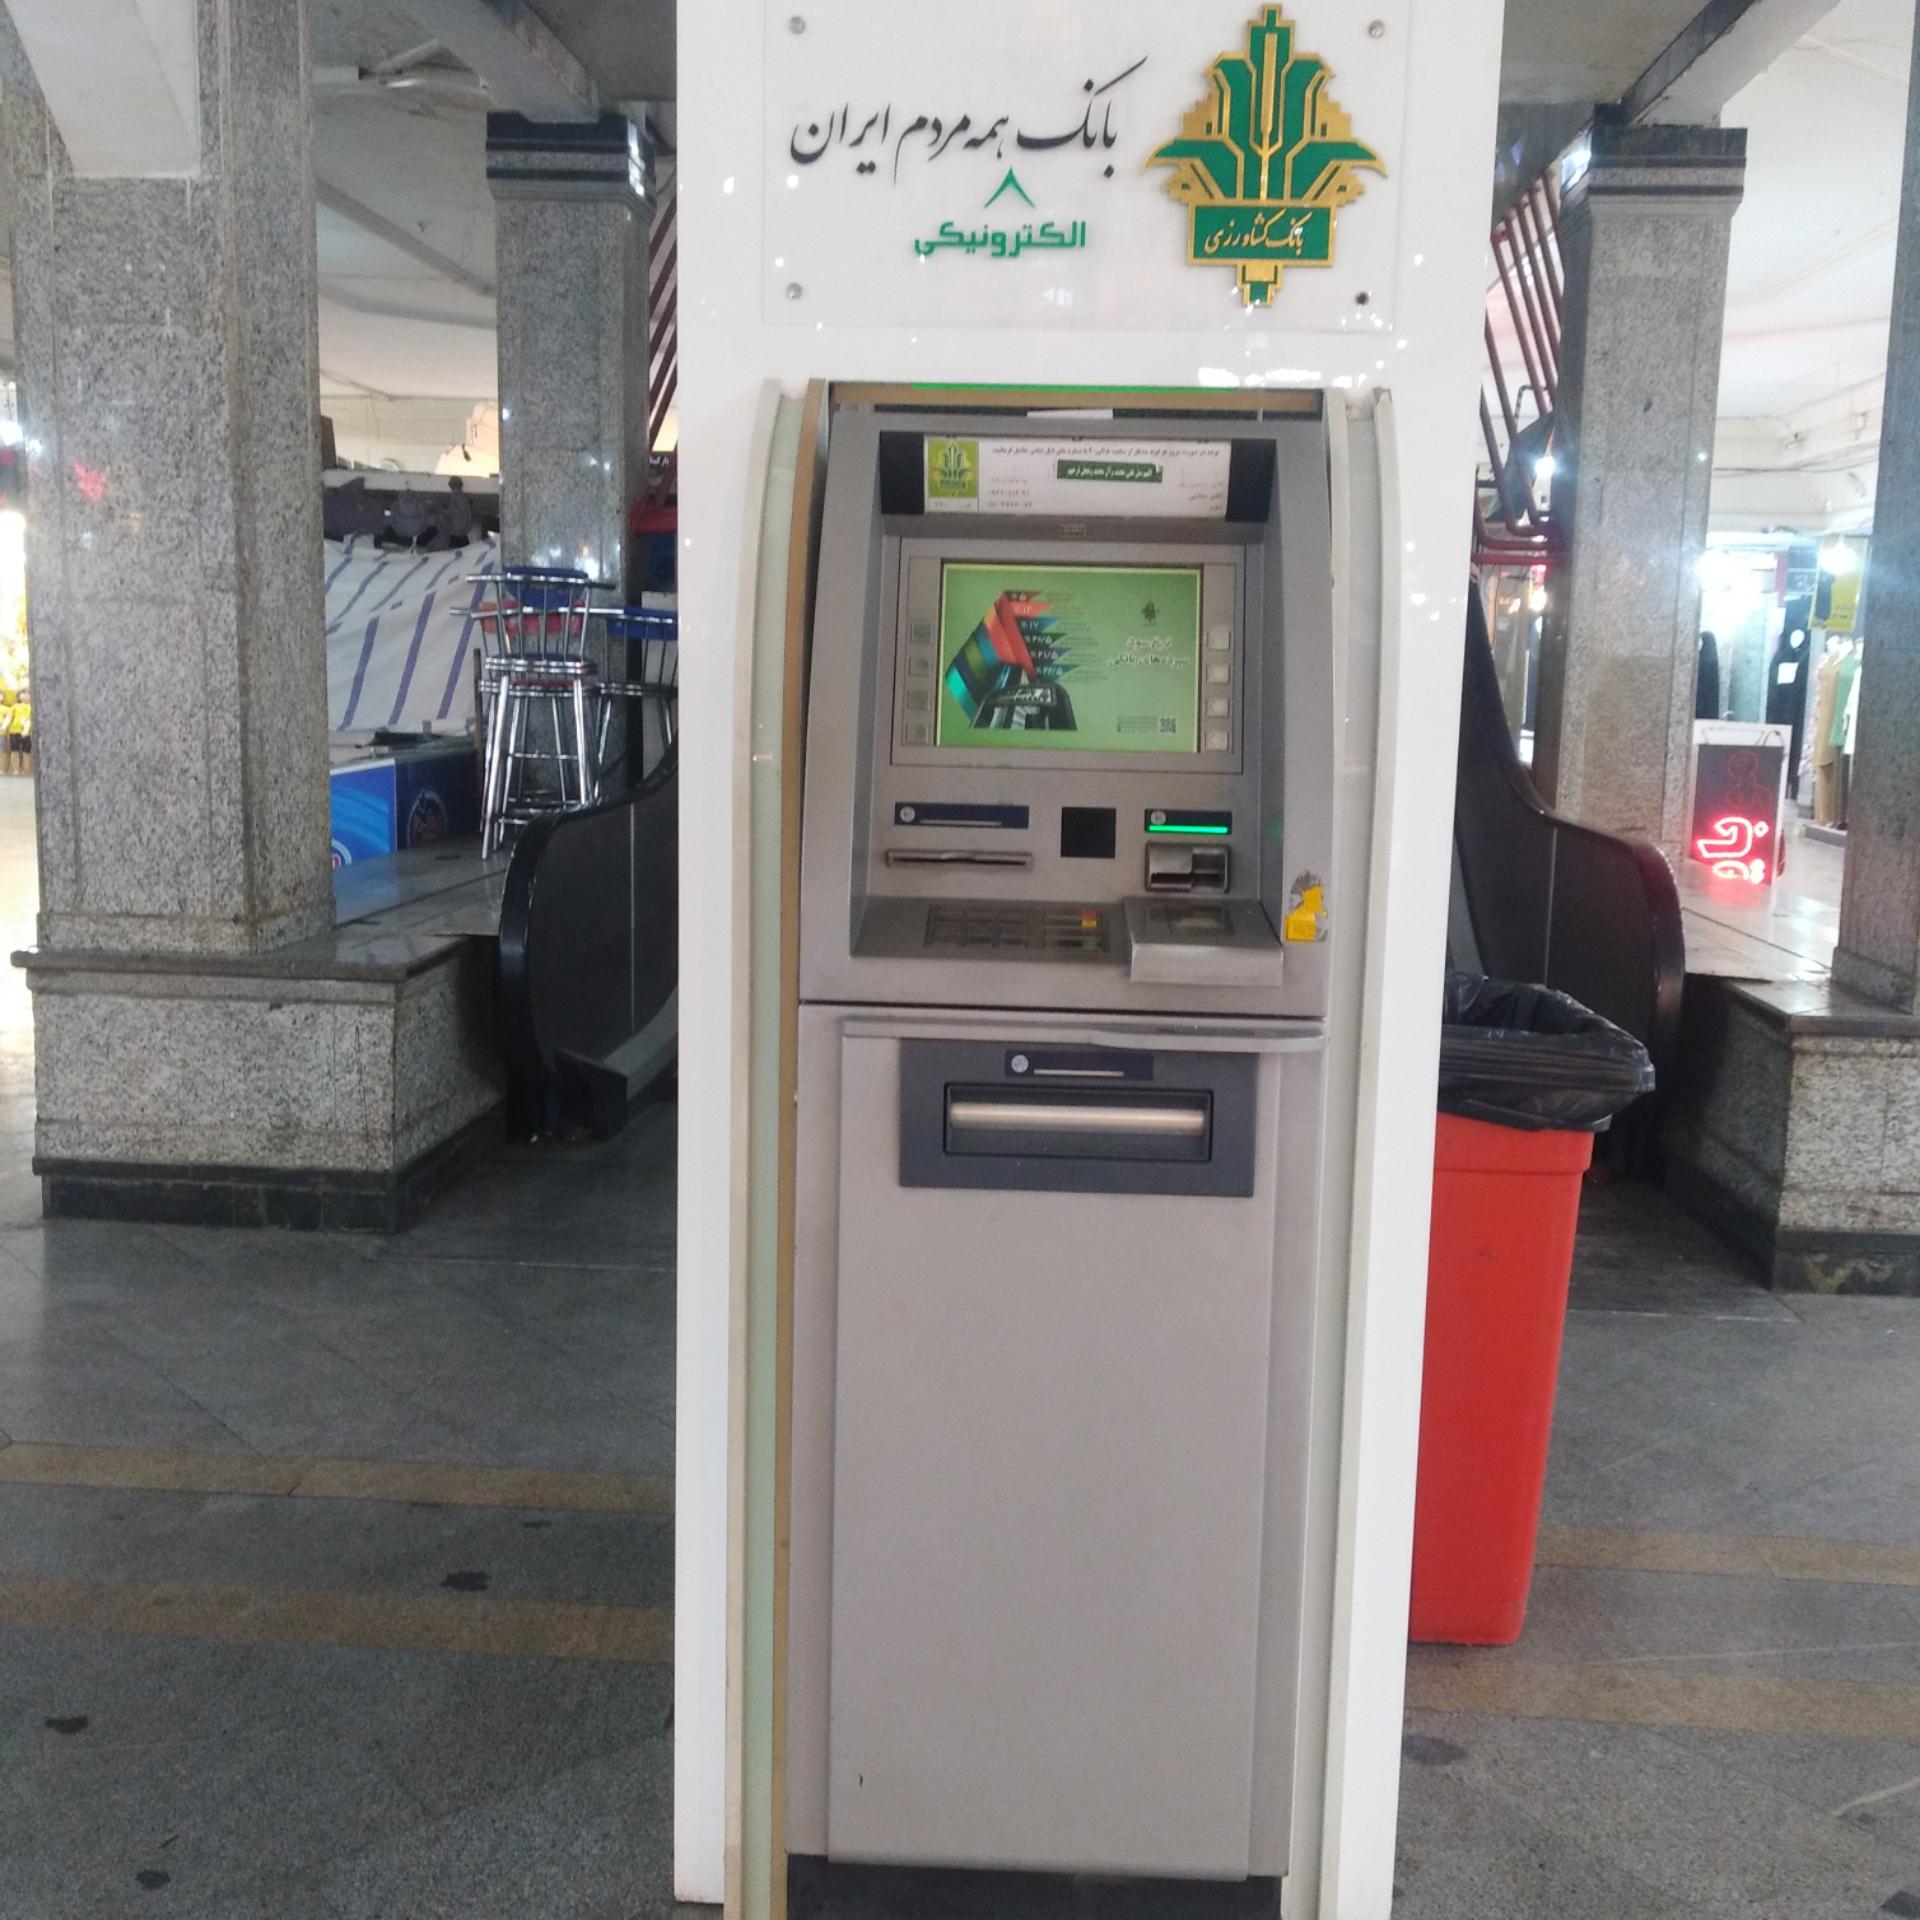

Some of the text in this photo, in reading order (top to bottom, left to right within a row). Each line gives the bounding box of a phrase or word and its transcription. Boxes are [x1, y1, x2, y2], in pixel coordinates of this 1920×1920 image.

[789, 55, 1149, 187] بانک همه مردم ایران
[914, 220, 1087, 258] الکترونیکی
[1203, 207, 1313, 257] بانک کشاورزی
